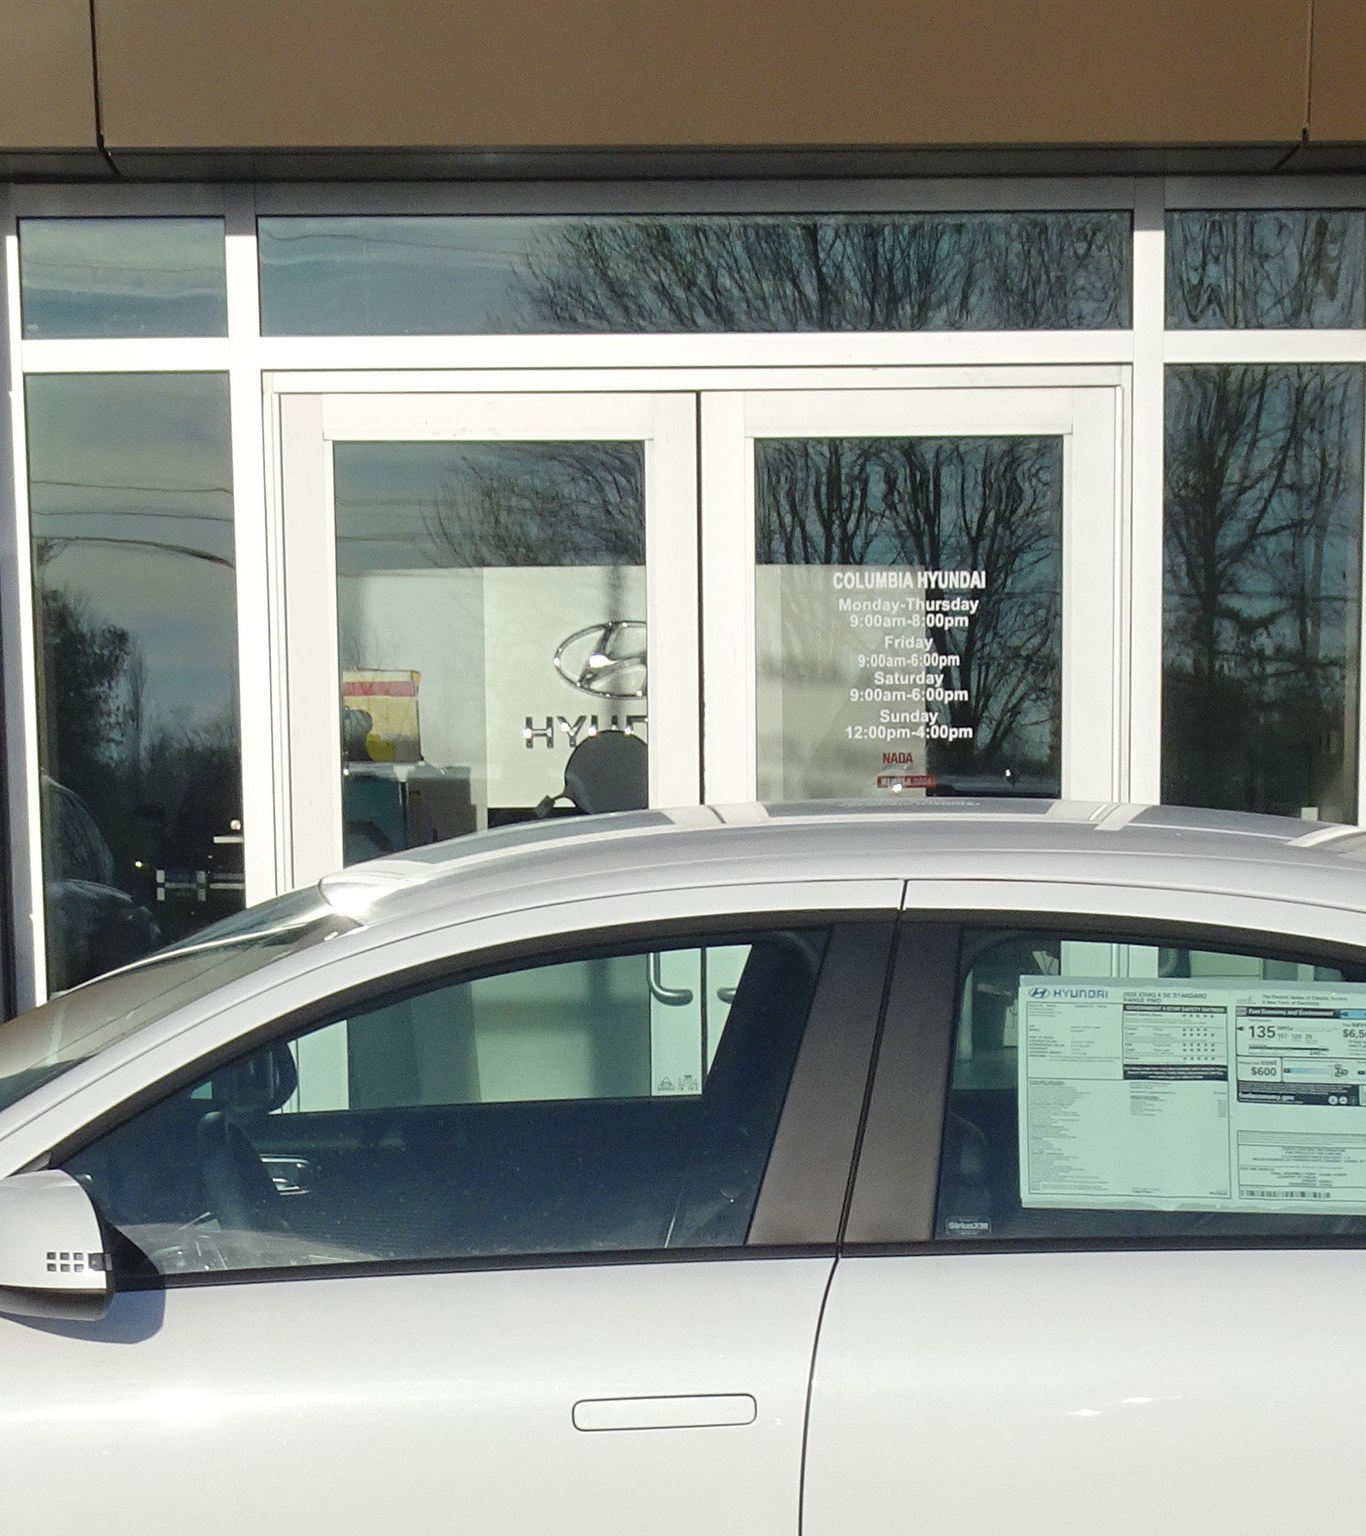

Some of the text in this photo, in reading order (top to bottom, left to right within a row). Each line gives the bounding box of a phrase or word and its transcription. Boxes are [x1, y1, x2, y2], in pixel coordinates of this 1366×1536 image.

[833, 571, 986, 589] COLUMBIA HYUNDAI
[838, 598, 979, 614] Monday-Thursday
[849, 615, 969, 630] 9:00am-8:00pm
[885, 635, 934, 651] Friday
[858, 653, 960, 669] 9:00am-6:00pm
[874, 671, 944, 687] Saturday
[849, 688, 969, 704] 9:00am-6:00pm
[879, 710, 939, 725] Sunday
[845, 726, 973, 741] 12:00pm-4:00pm
[882, 752, 913, 764] NADA
[1053, 989, 1108, 999] HYUNDAI
[1248, 1025, 1276, 1039] 135
[1251, 1066, 1277, 1076] $600
